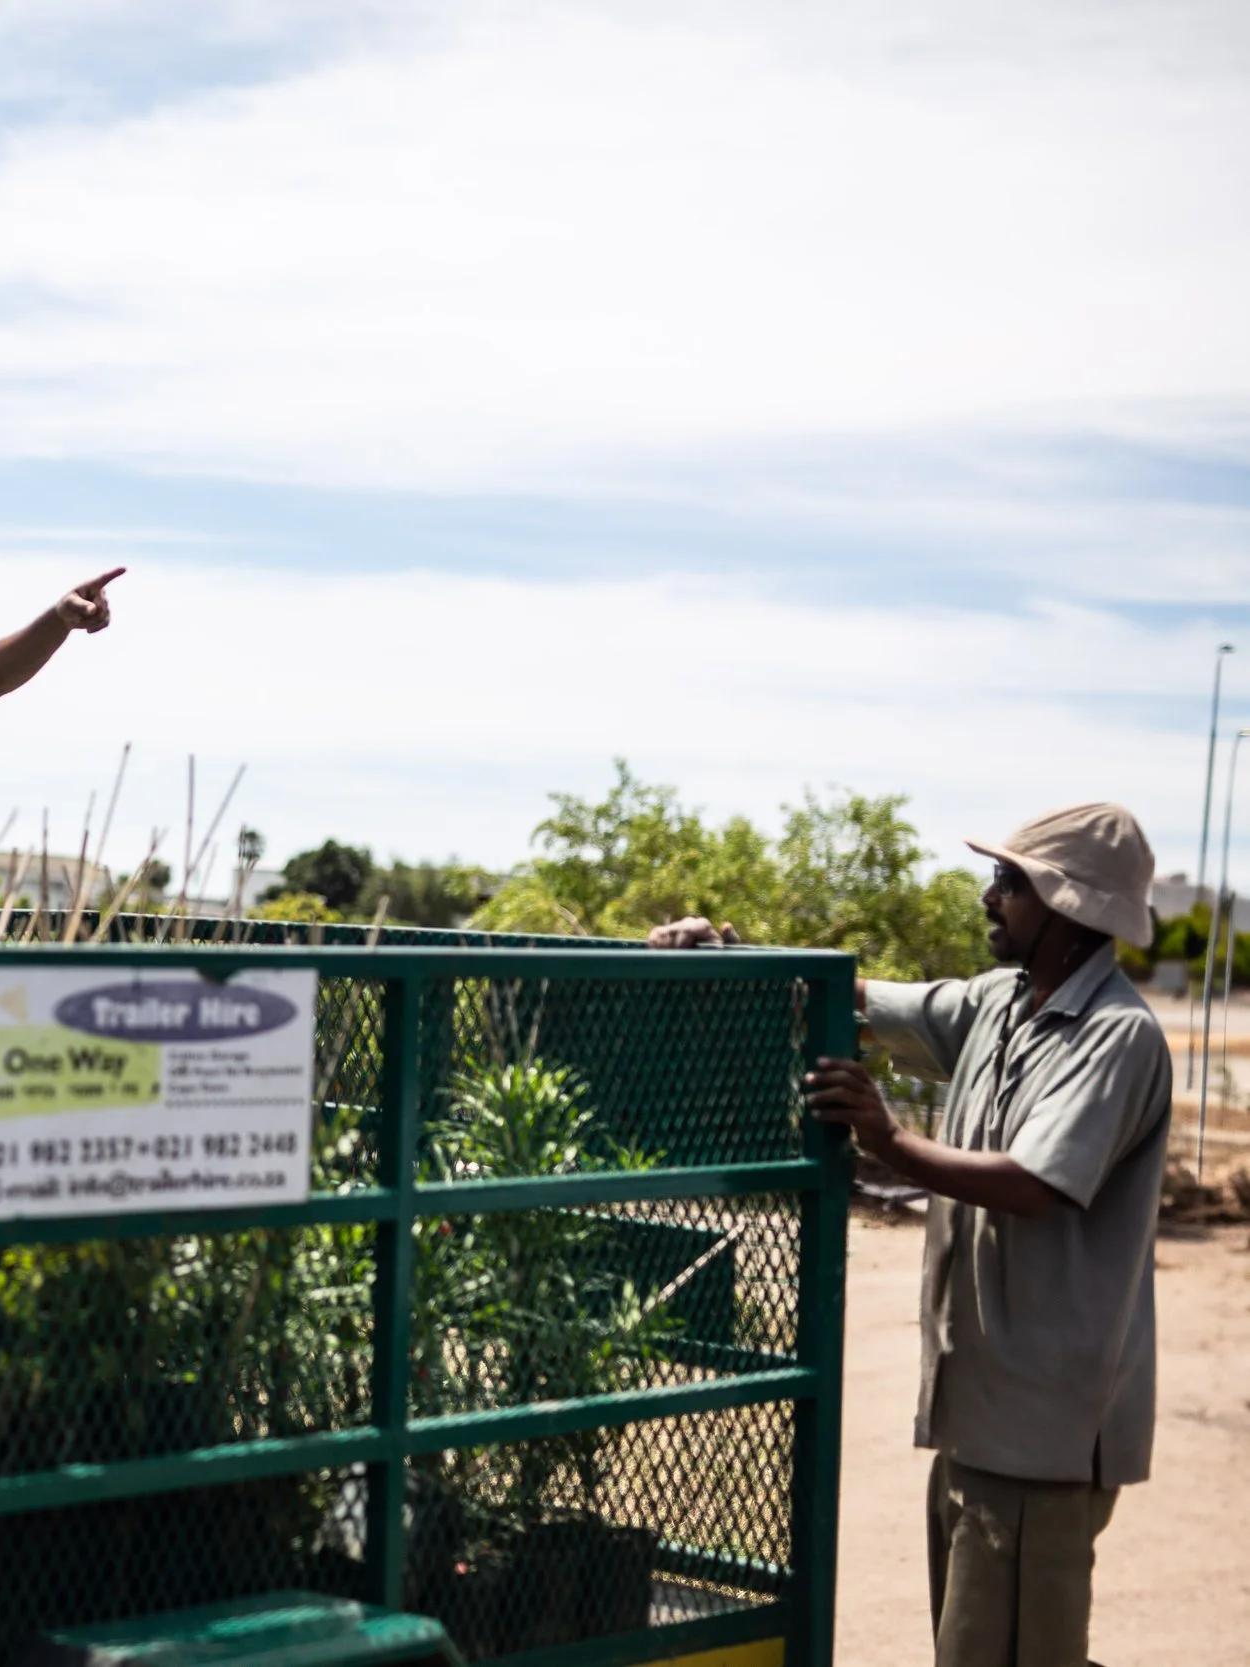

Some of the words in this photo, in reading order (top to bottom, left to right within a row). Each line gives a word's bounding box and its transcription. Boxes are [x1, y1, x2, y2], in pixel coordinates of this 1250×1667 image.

[92, 996, 191, 1028] Trailer
[200, 995, 261, 1028] Hire
[4, 1047, 63, 1077] One
[68, 1046, 129, 1078] Way
